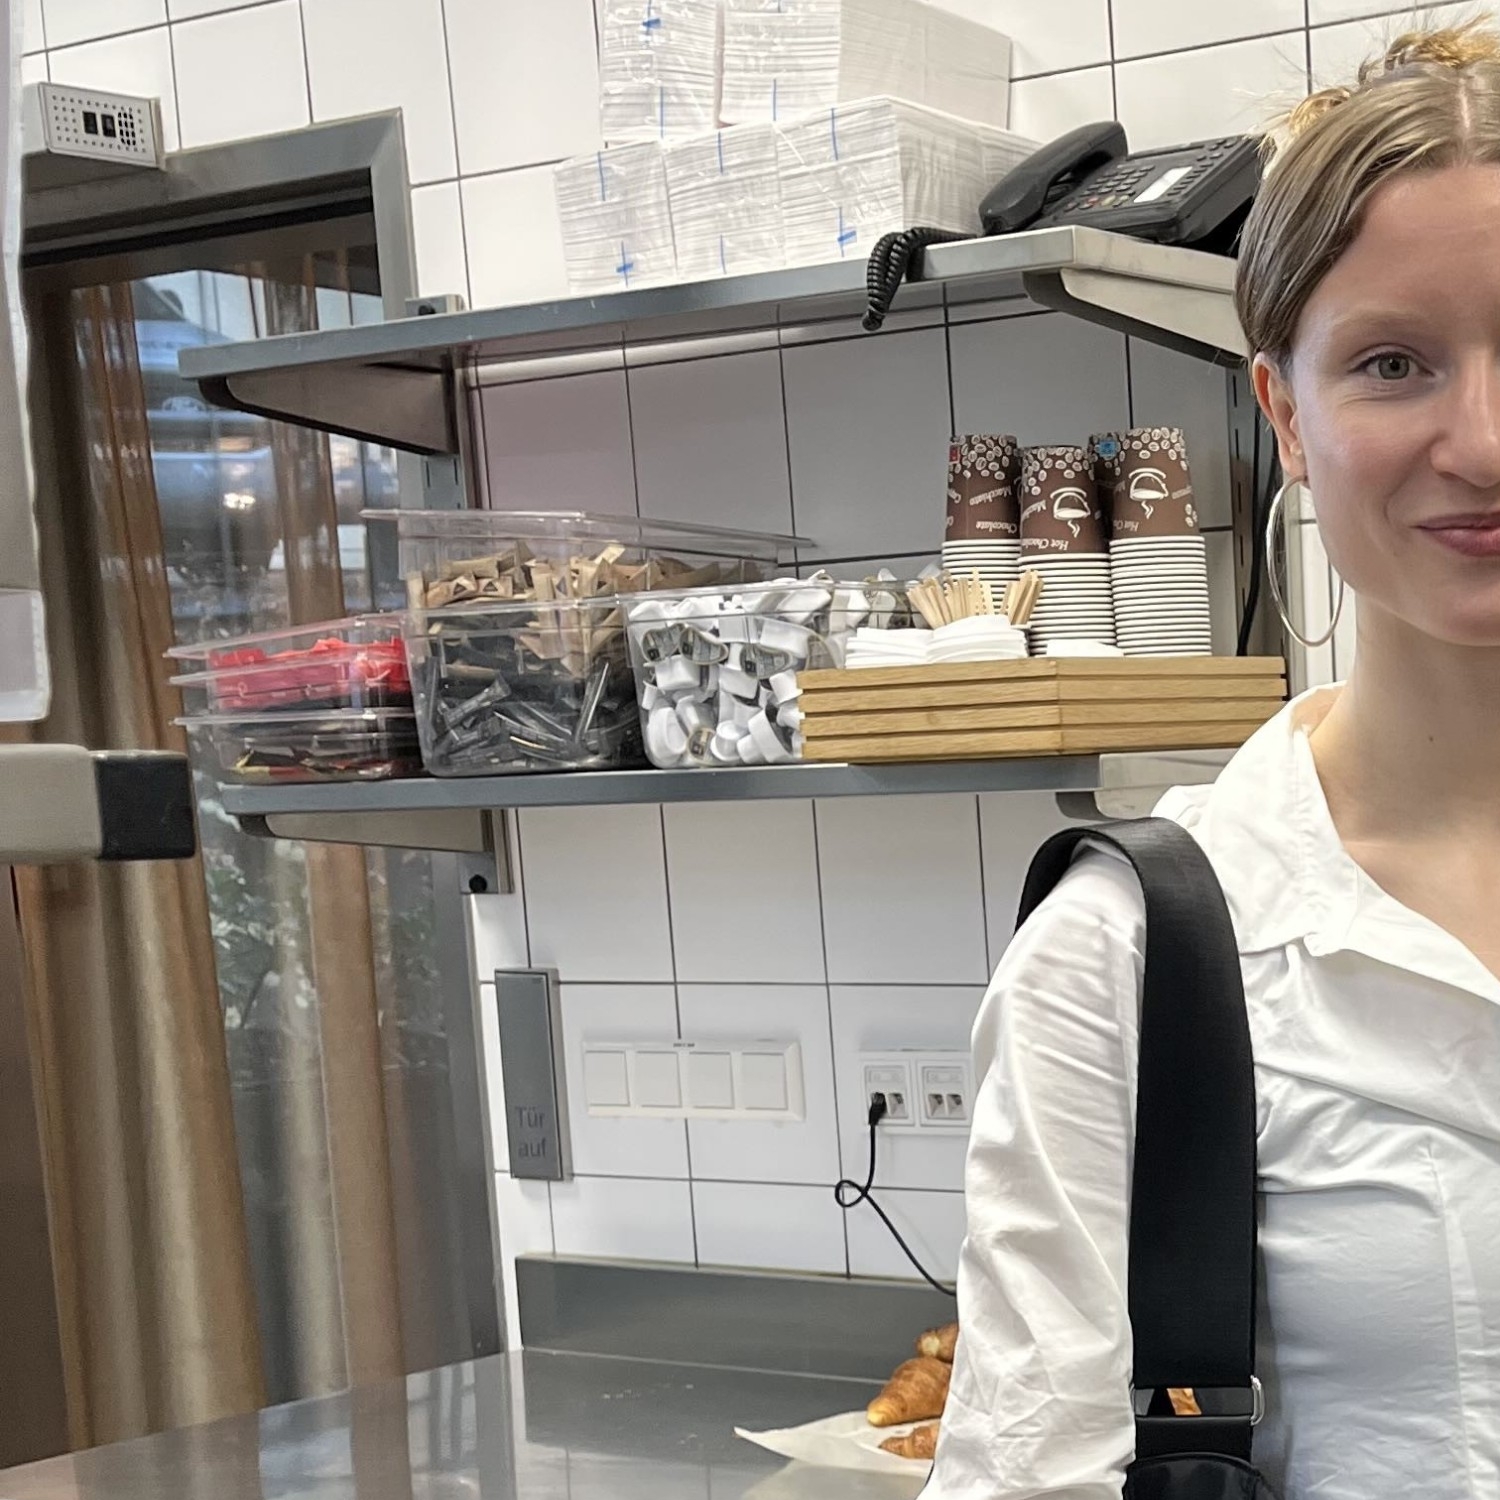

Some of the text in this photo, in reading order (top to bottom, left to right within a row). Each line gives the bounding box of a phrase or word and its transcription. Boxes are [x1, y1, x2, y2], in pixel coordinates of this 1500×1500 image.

[976, 521, 1017, 534] Chocolate
[1050, 538, 1069, 551] Hot
[515, 1106, 545, 1128] Tür
[518, 1137, 546, 1157] auf
